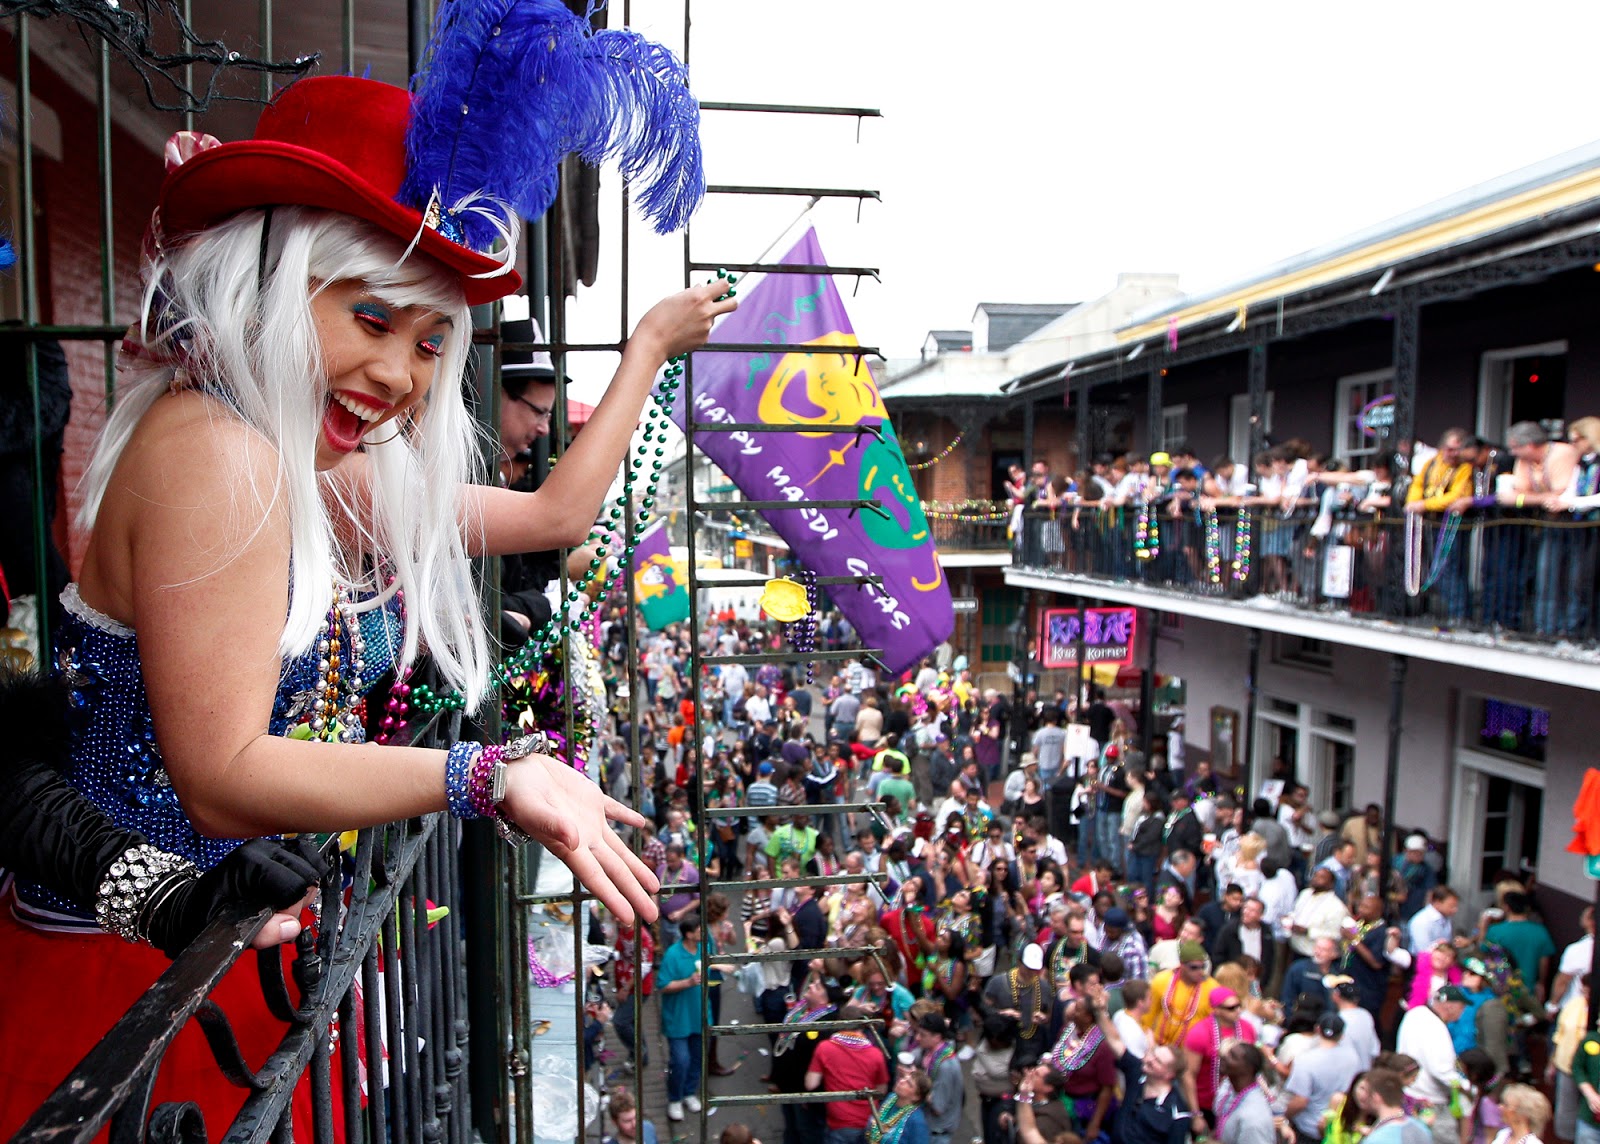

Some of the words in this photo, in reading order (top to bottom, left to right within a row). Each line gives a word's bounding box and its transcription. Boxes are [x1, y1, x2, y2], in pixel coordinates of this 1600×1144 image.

[695, 392, 762, 455] HAPPY
[766, 466, 838, 540] MARDI
[1085, 646, 1128, 660] Korner
